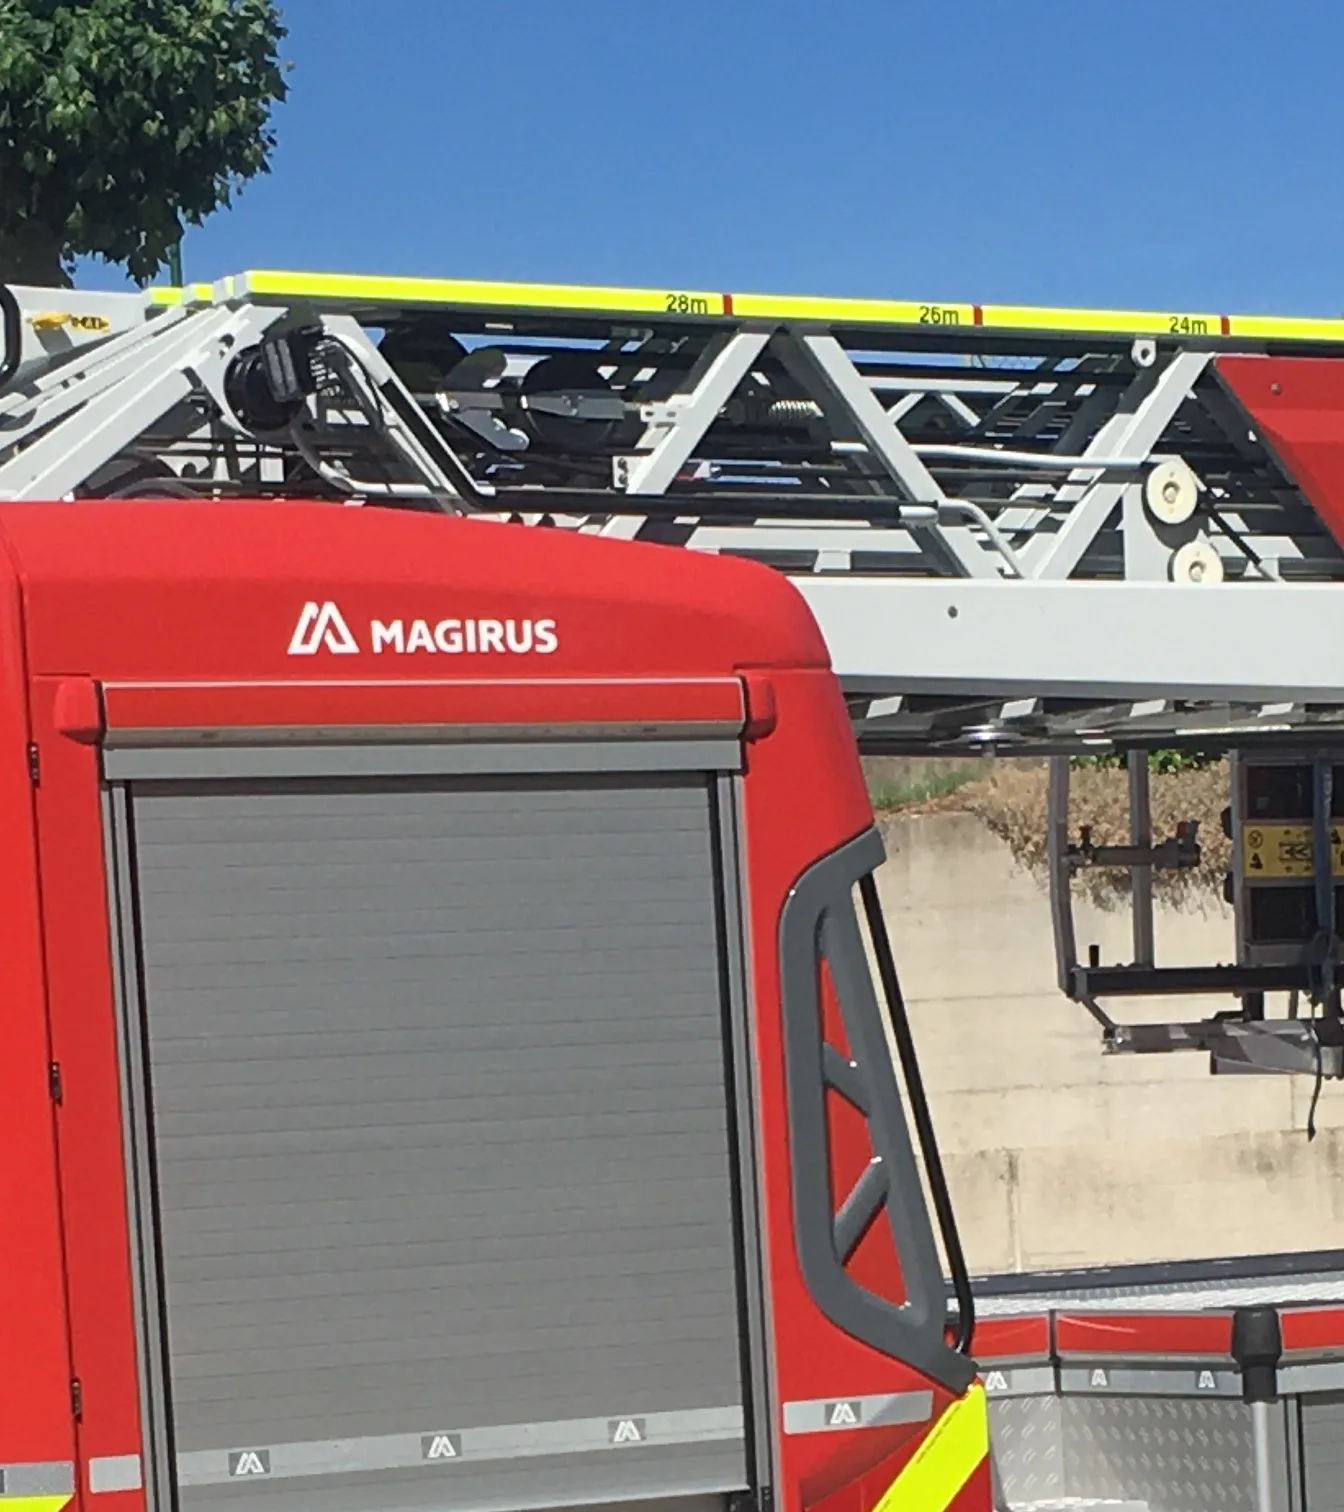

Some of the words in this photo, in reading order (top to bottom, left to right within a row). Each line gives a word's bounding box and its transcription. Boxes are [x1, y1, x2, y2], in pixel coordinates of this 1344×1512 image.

[666, 293, 708, 315] 28m
[919, 305, 959, 325] 26m
[1169, 315, 1207, 335] 24m
[370, 619, 558, 654] MAGIRUS
